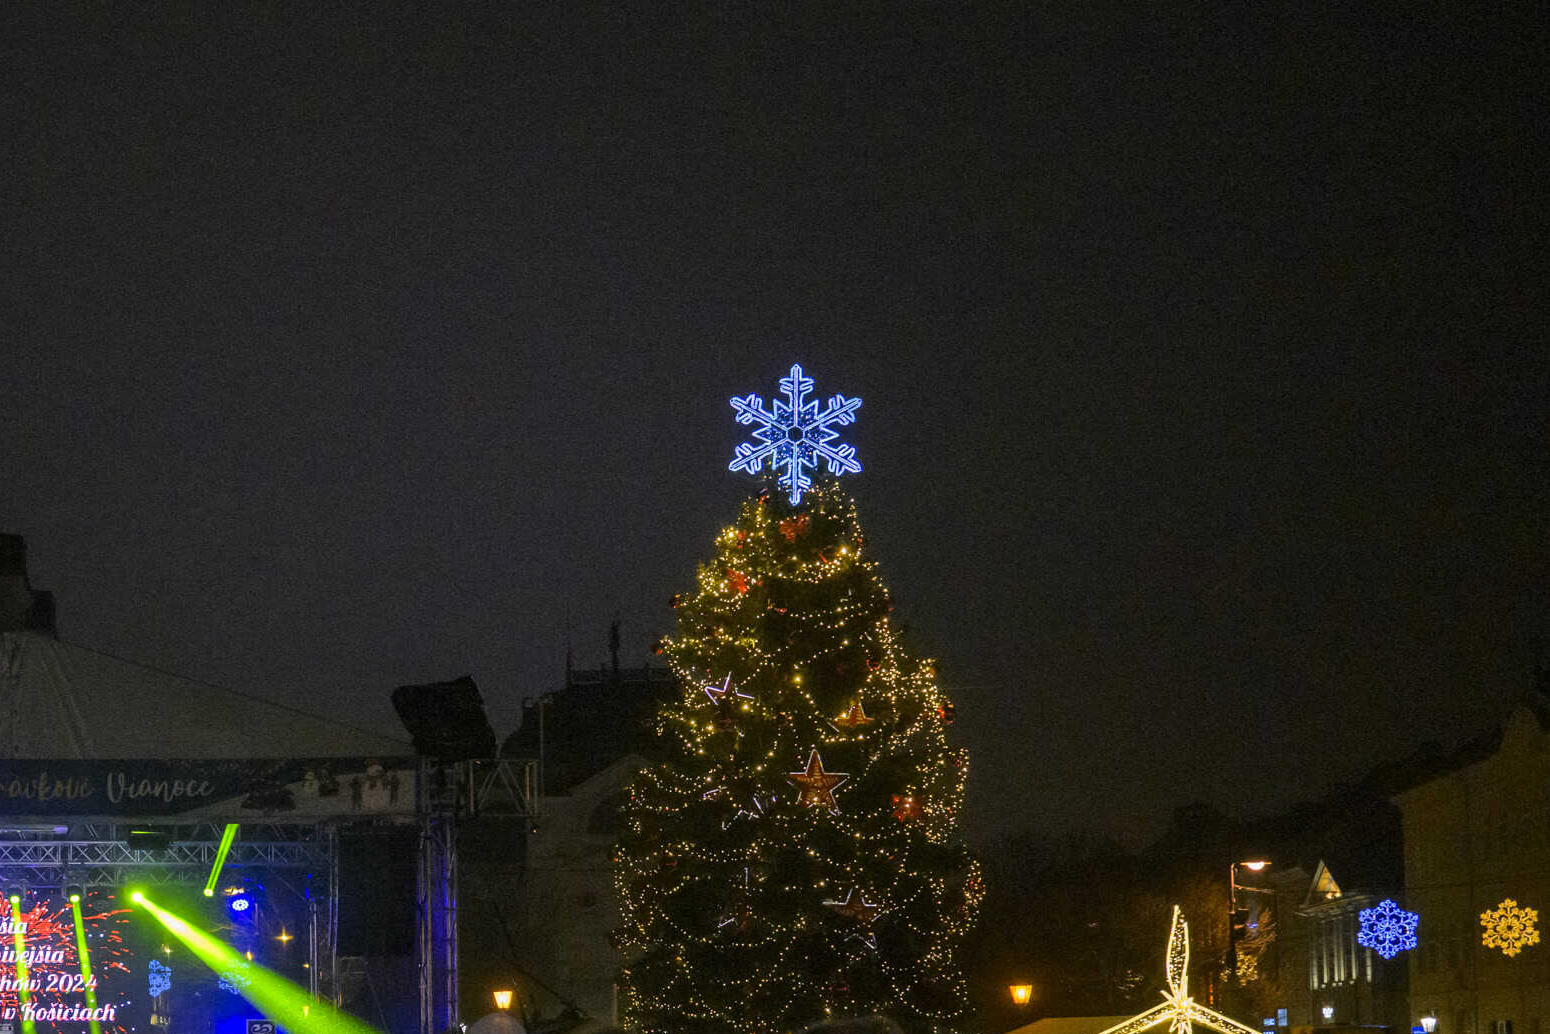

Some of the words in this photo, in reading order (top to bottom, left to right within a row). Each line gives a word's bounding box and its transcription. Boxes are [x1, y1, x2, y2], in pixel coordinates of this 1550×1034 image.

[106, 771, 215, 803] Vianoce
[46, 973, 99, 993] 2024
[20, 1002, 116, 1022] Košiciach
